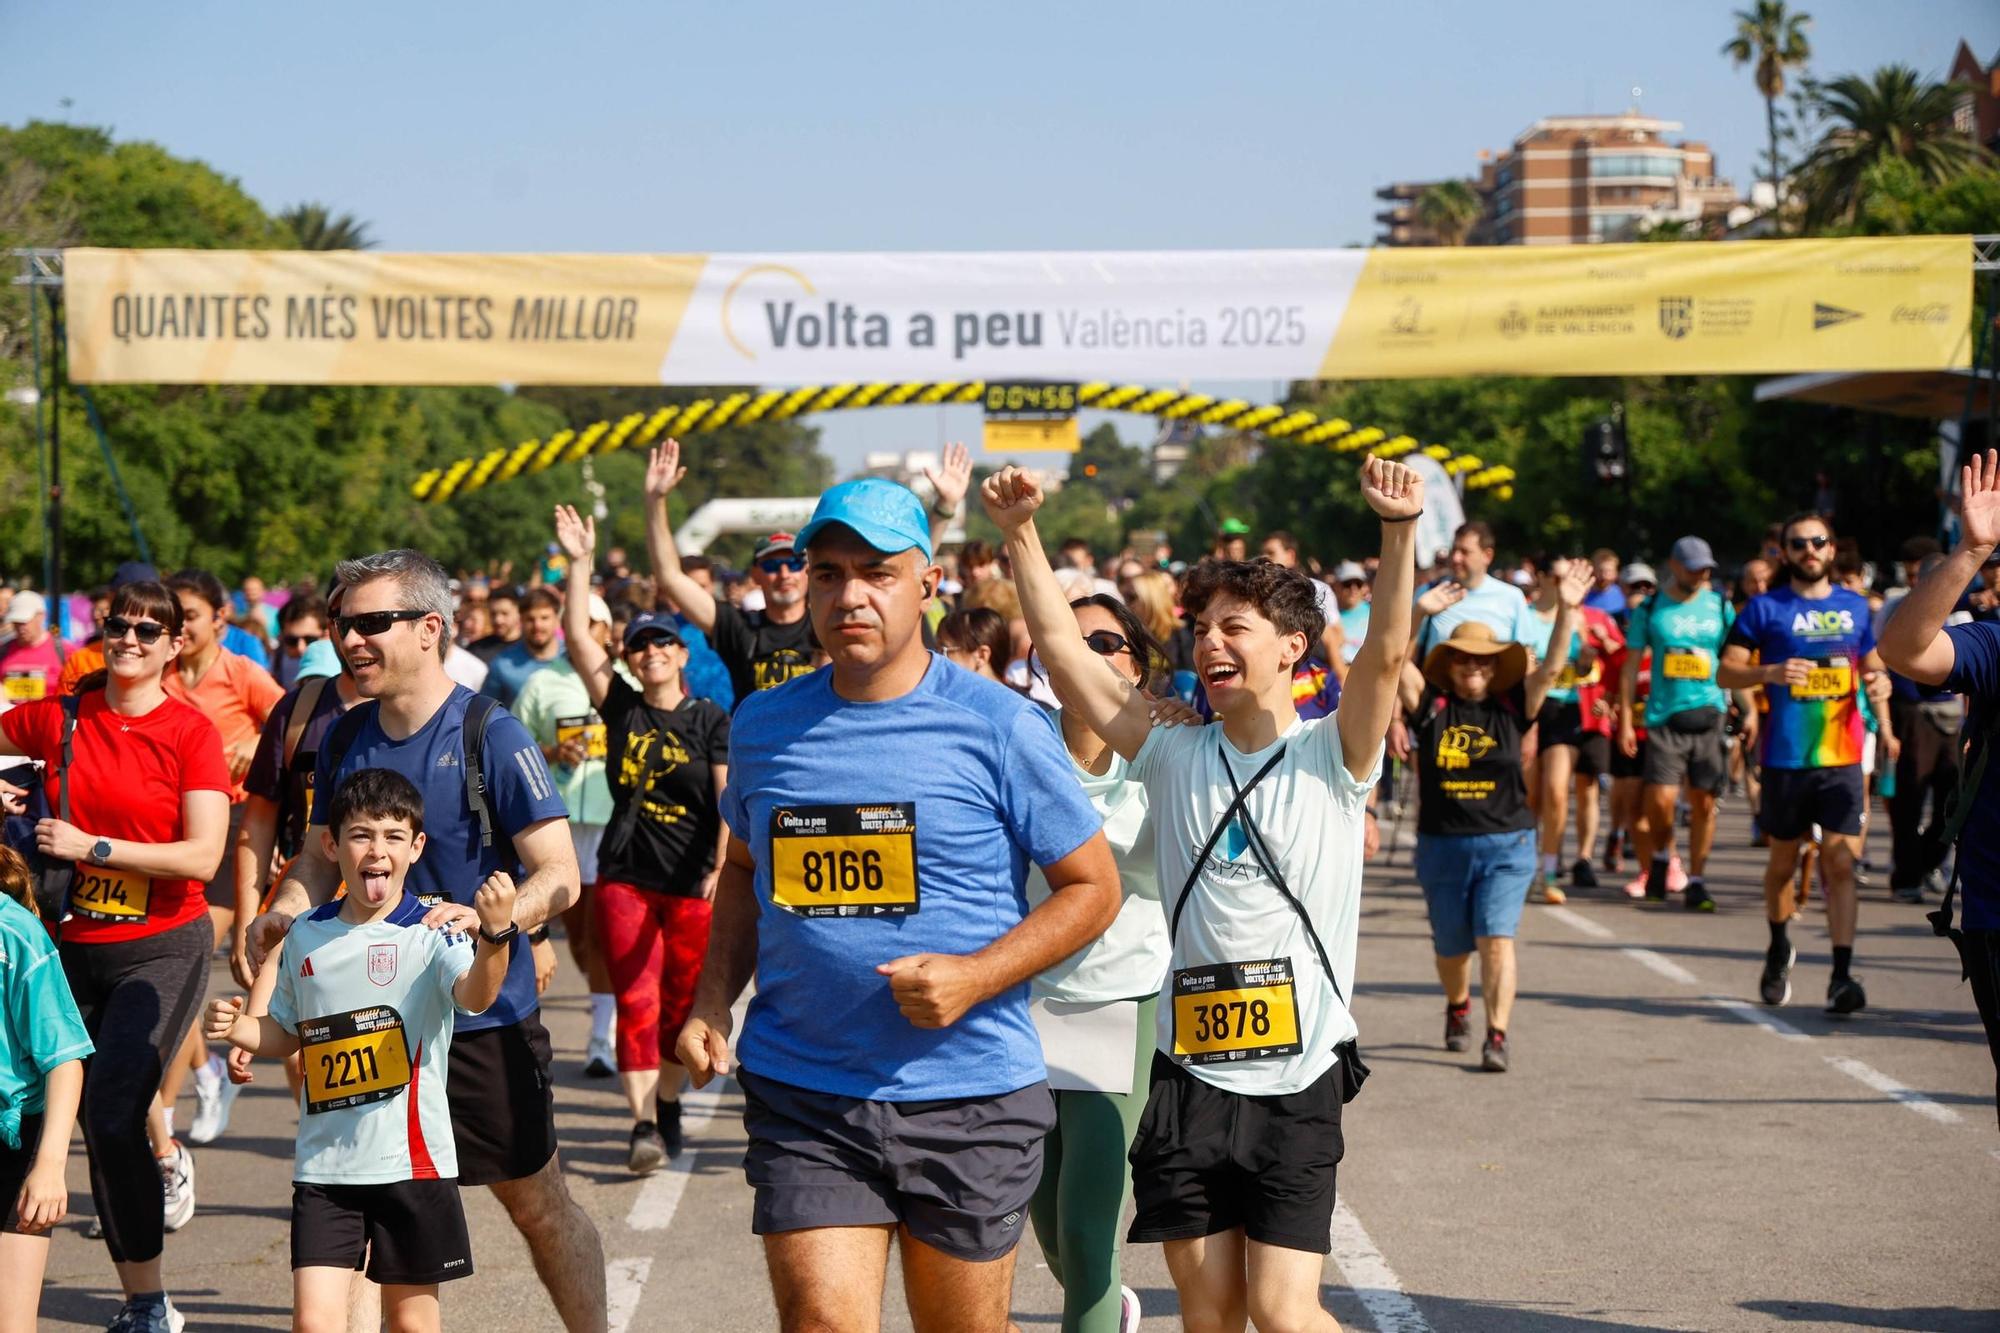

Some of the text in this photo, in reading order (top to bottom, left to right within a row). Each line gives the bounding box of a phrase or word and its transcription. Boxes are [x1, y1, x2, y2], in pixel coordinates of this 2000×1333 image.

[111, 284, 638, 343] QUANTES MÉS VOLTES MILLOR
[765, 301, 1306, 359] Volta a peu València 2025
[784, 816, 826, 828] Volta a peu
[73, 872, 127, 905] 2214
[802, 849, 883, 893] 8166
[1193, 999, 1271, 1042] 3878
[321, 1045, 379, 1090] 2211
[443, 1258, 465, 1269] KIPSTA
